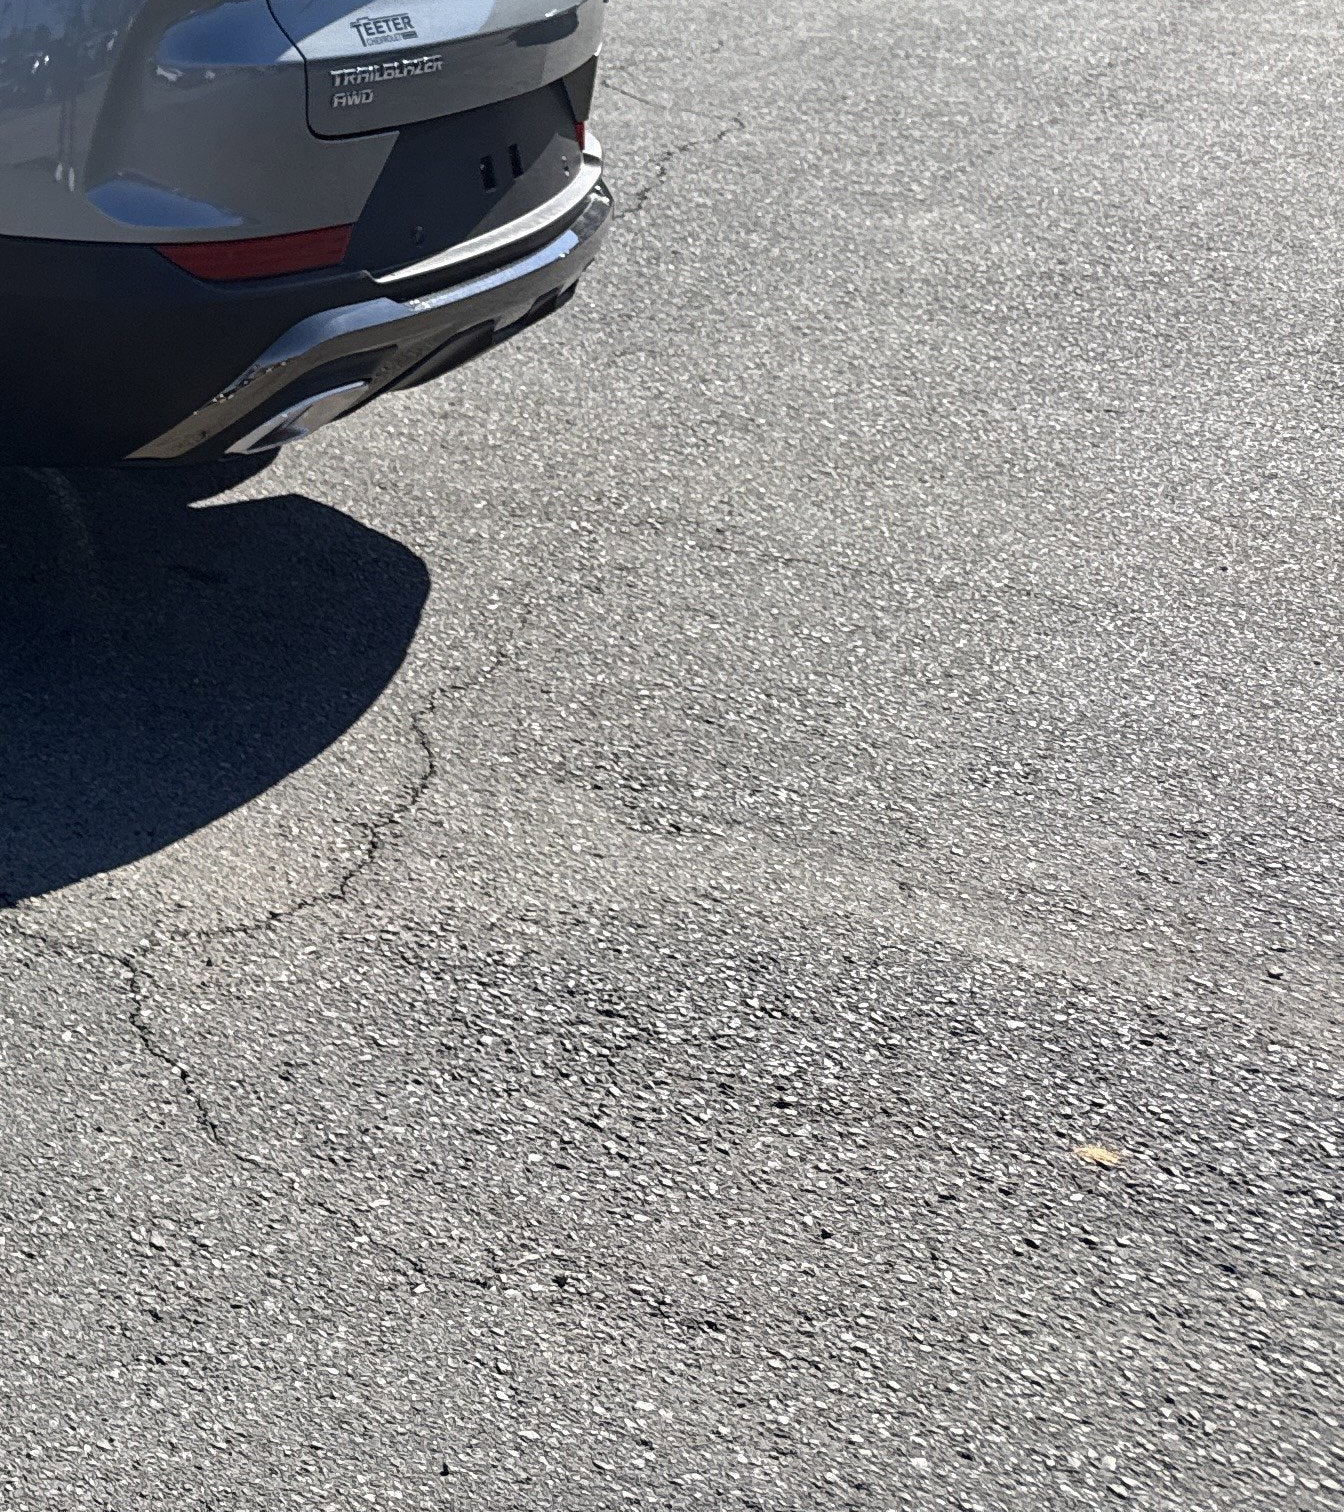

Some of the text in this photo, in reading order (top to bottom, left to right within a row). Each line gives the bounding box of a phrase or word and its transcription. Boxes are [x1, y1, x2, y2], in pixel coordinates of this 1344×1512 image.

[352, 15, 415, 46] TEETER
[330, 55, 443, 86] TRAILBLAZER
[332, 89, 374, 108] AWD
